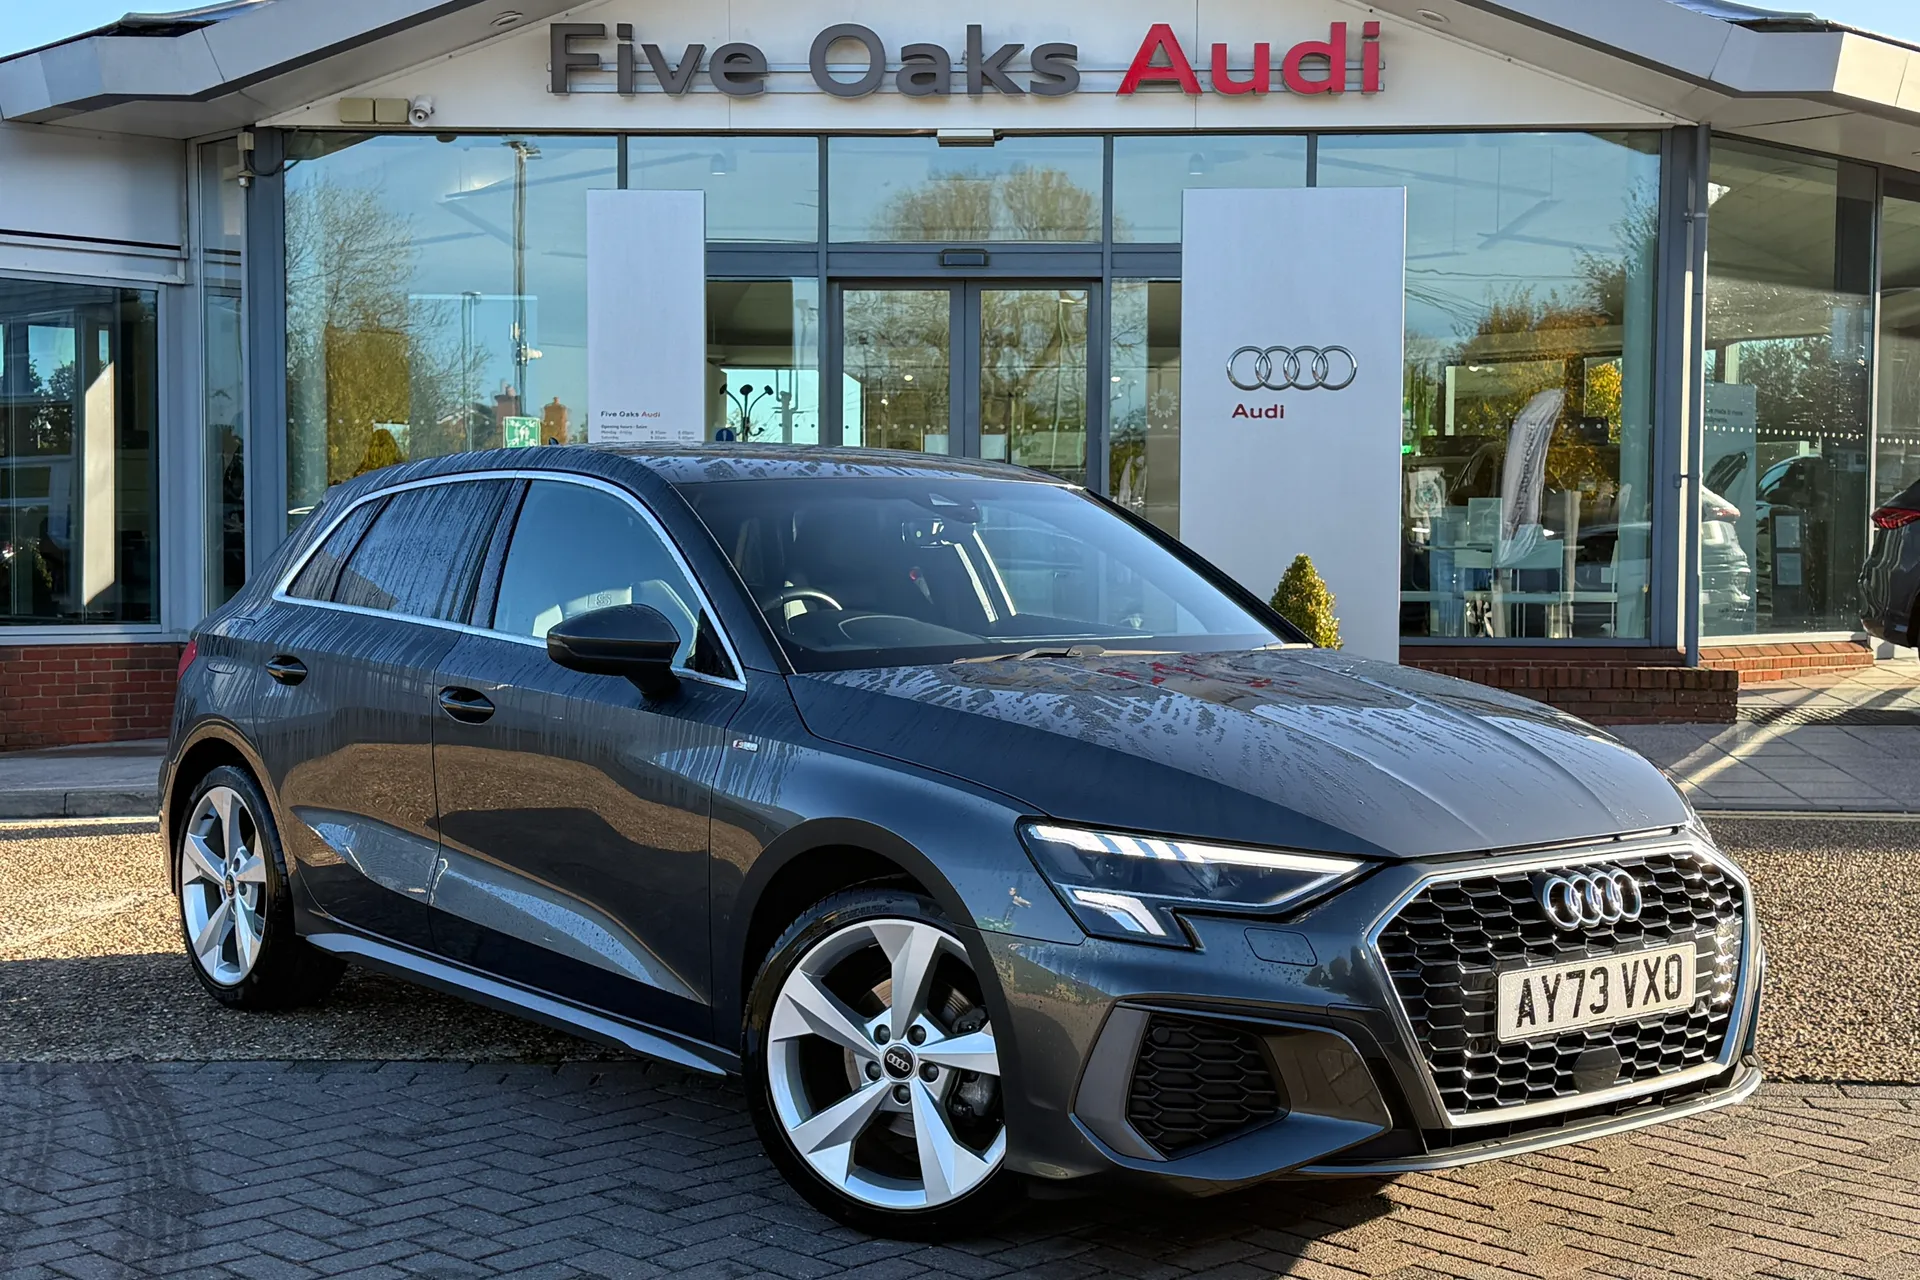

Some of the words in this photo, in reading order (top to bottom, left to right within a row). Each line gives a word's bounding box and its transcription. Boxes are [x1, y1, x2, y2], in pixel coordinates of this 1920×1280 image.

[550, 23, 769, 98] Five
[809, 23, 1081, 98] Oaks
[1116, 21, 1381, 96] Audi
[1231, 403, 1285, 419] Audi
[1515, 966, 1609, 1029] AY73
[1621, 953, 1682, 1009] VXO
